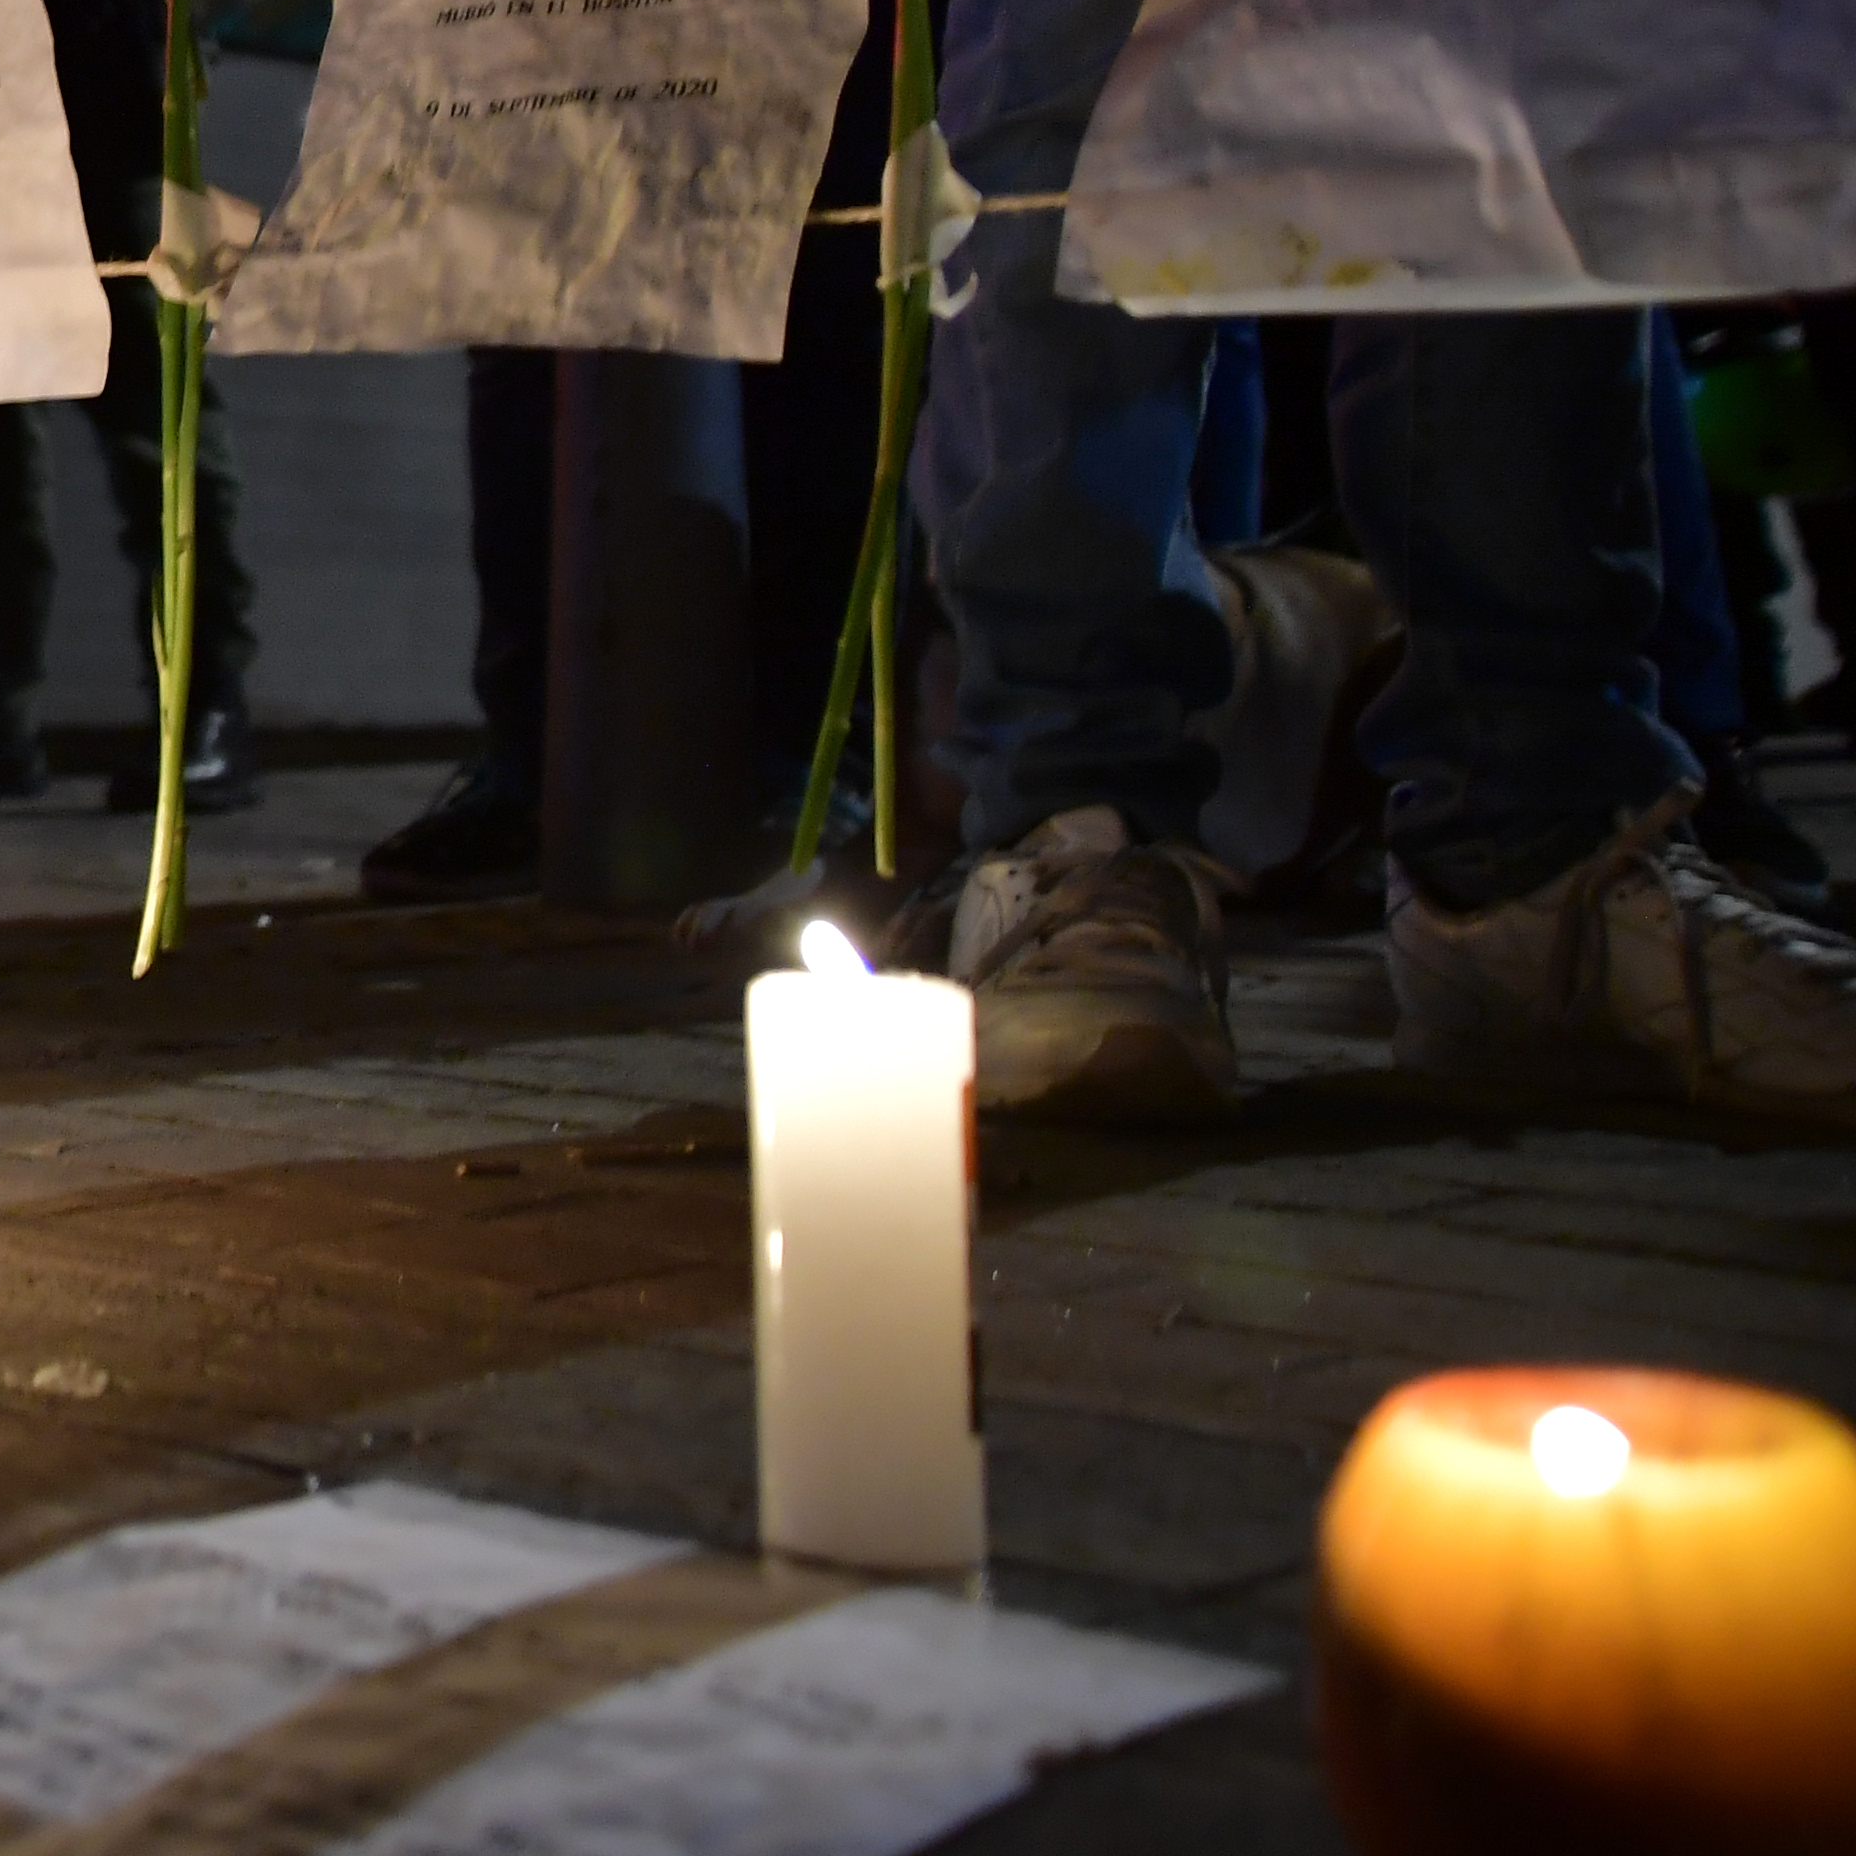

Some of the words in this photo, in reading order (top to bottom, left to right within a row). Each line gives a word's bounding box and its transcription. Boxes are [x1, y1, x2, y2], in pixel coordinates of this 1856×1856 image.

[426, 100, 439, 117] 9
[449, 100, 472, 118] DE
[486, 85, 598, 119] SEPTIEMBRE
[614, 84, 638, 103] DE
[653, 77, 718, 100] 2020
